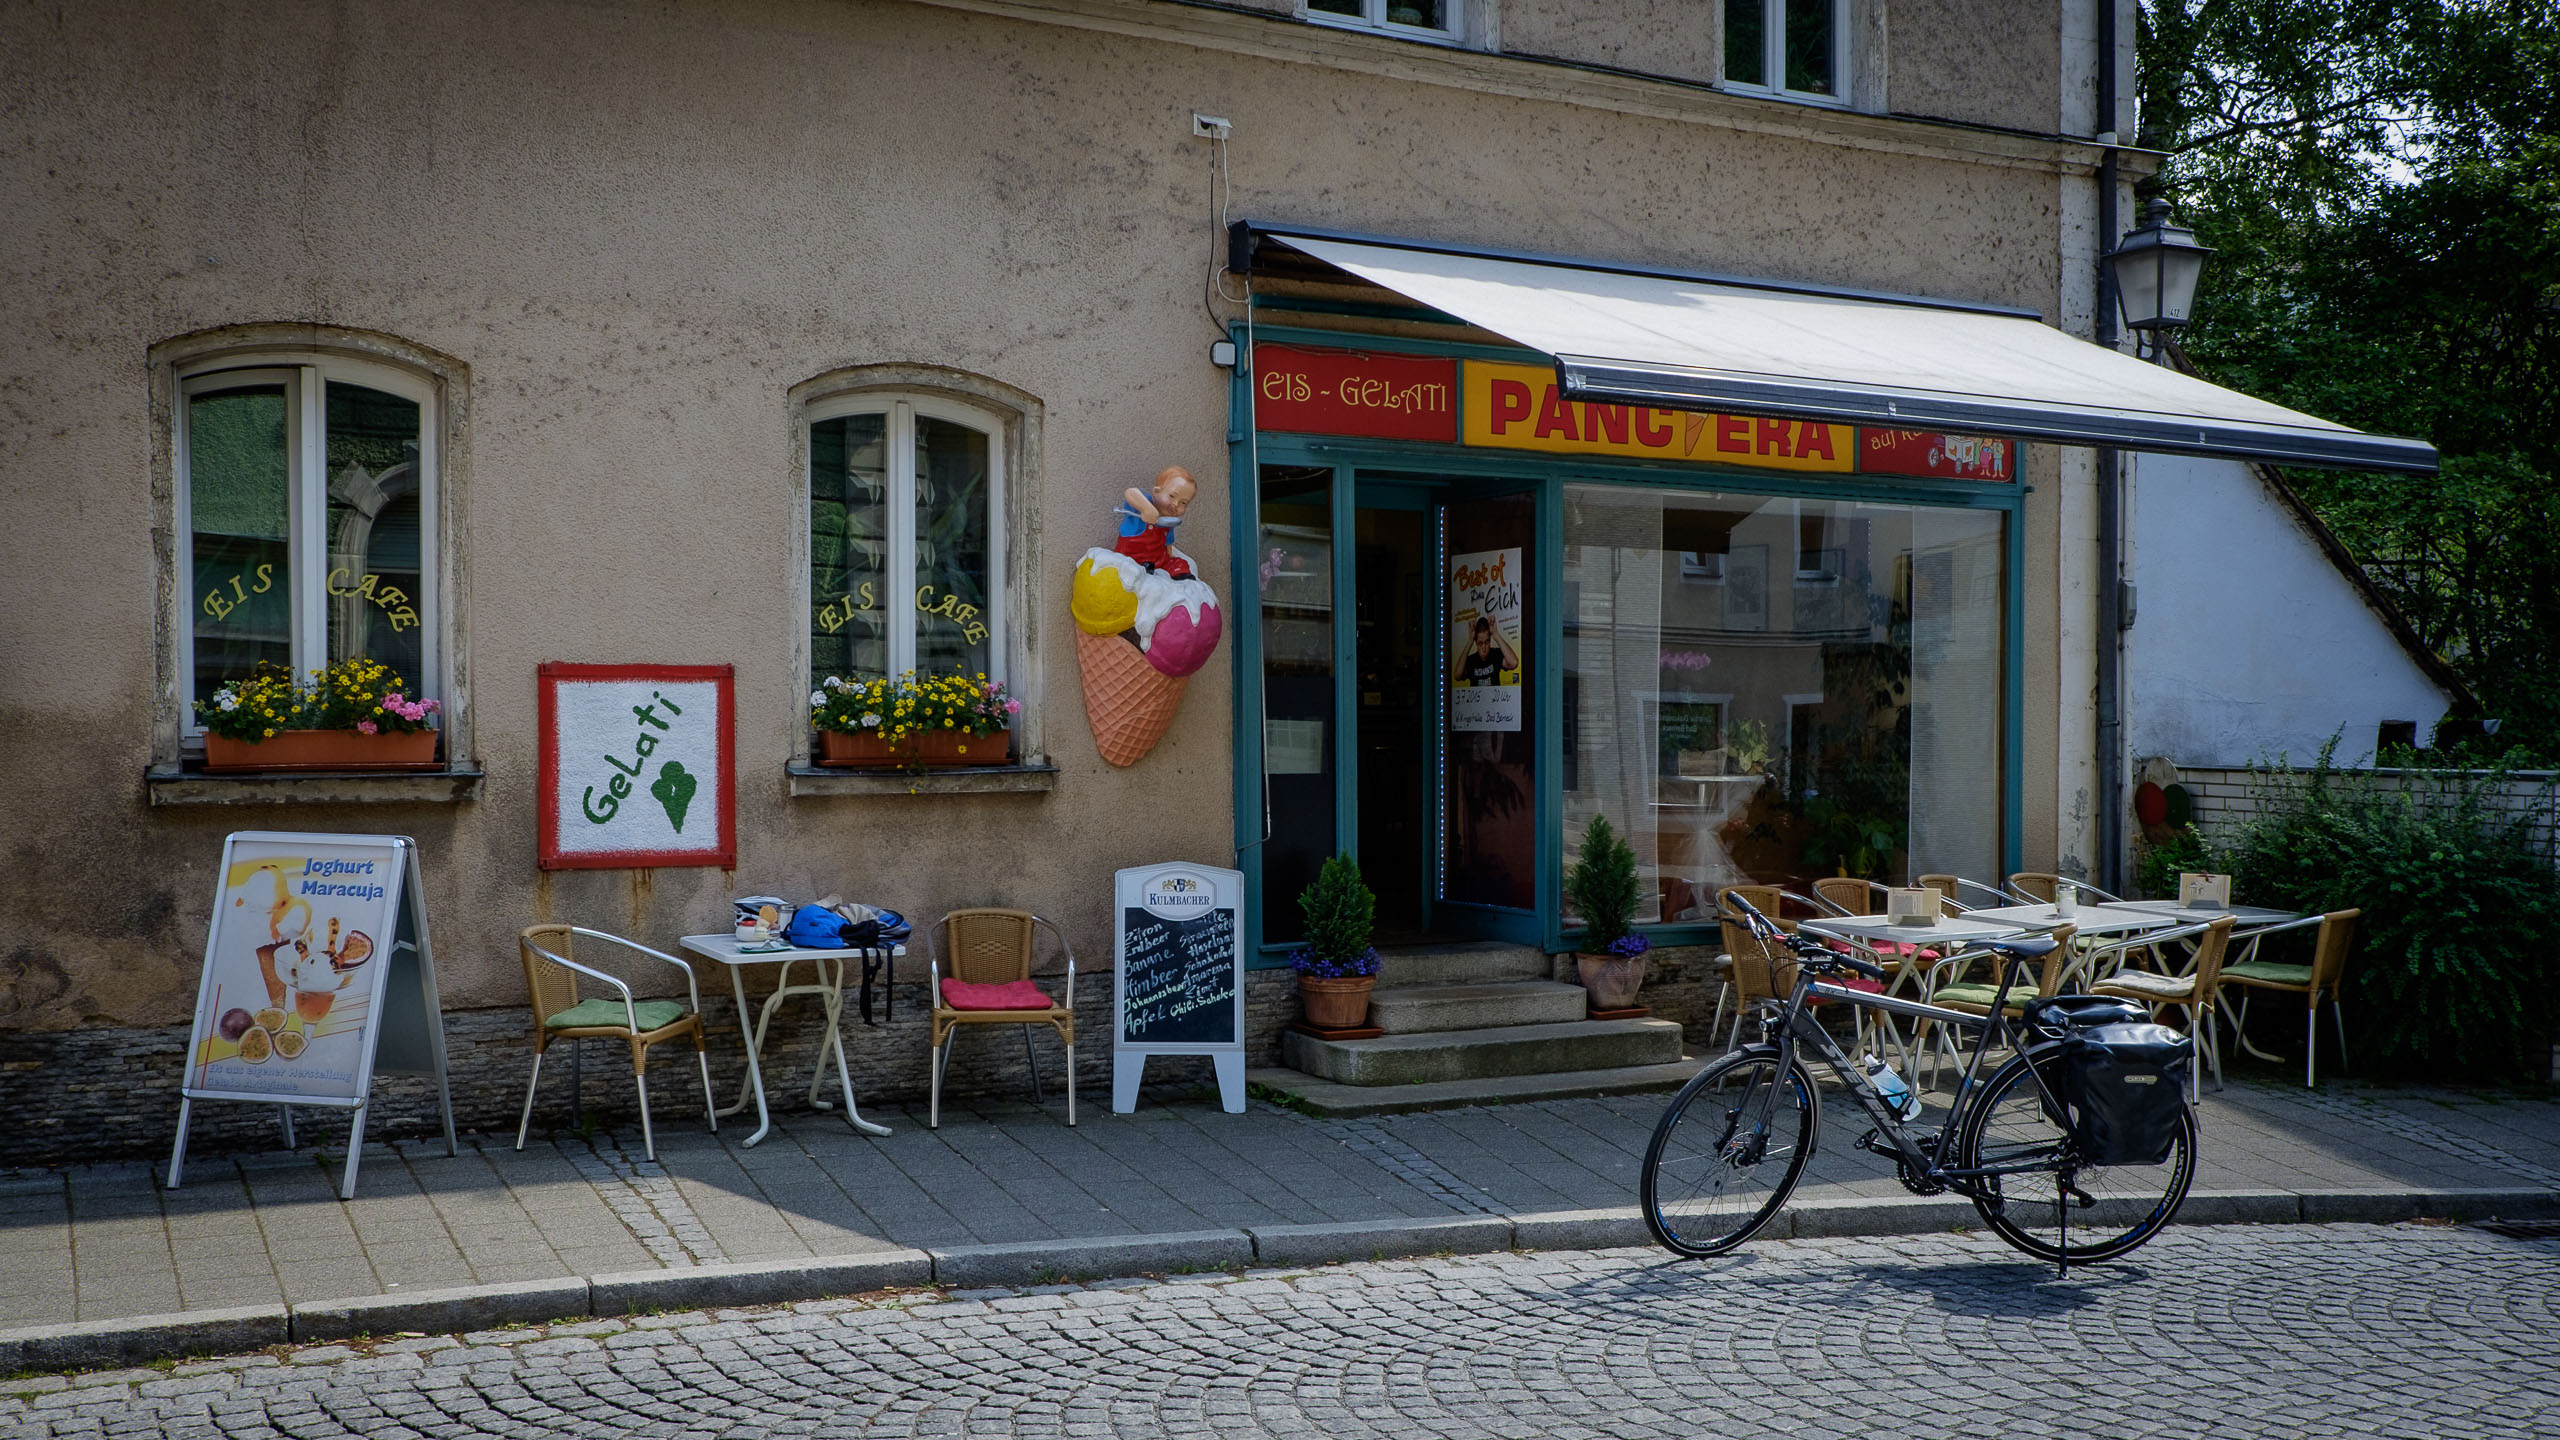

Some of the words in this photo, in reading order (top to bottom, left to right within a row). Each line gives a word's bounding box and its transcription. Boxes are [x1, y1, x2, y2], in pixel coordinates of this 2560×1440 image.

[1263, 371, 1311, 402] EIS
[1339, 376, 1447, 414] GELATI
[1453, 562, 1488, 591] Best
[1490, 553, 1506, 587] of
[203, 563, 273, 622] EIS
[326, 567, 421, 632] CAFE
[1485, 582, 1519, 613] Eich
[819, 581, 875, 634] EIS
[916, 584, 990, 646] CAFE
[303, 857, 374, 878] Joghurt
[301, 880, 385, 902] Maracuja
[1149, 893, 1210, 906] KULMBACHER
[1125, 949, 1175, 977] Banane
[1125, 969, 1178, 997] Himbeer
[1124, 1004, 1166, 1036] Apfel
[1819, 1043, 1905, 1141] STEVENS
